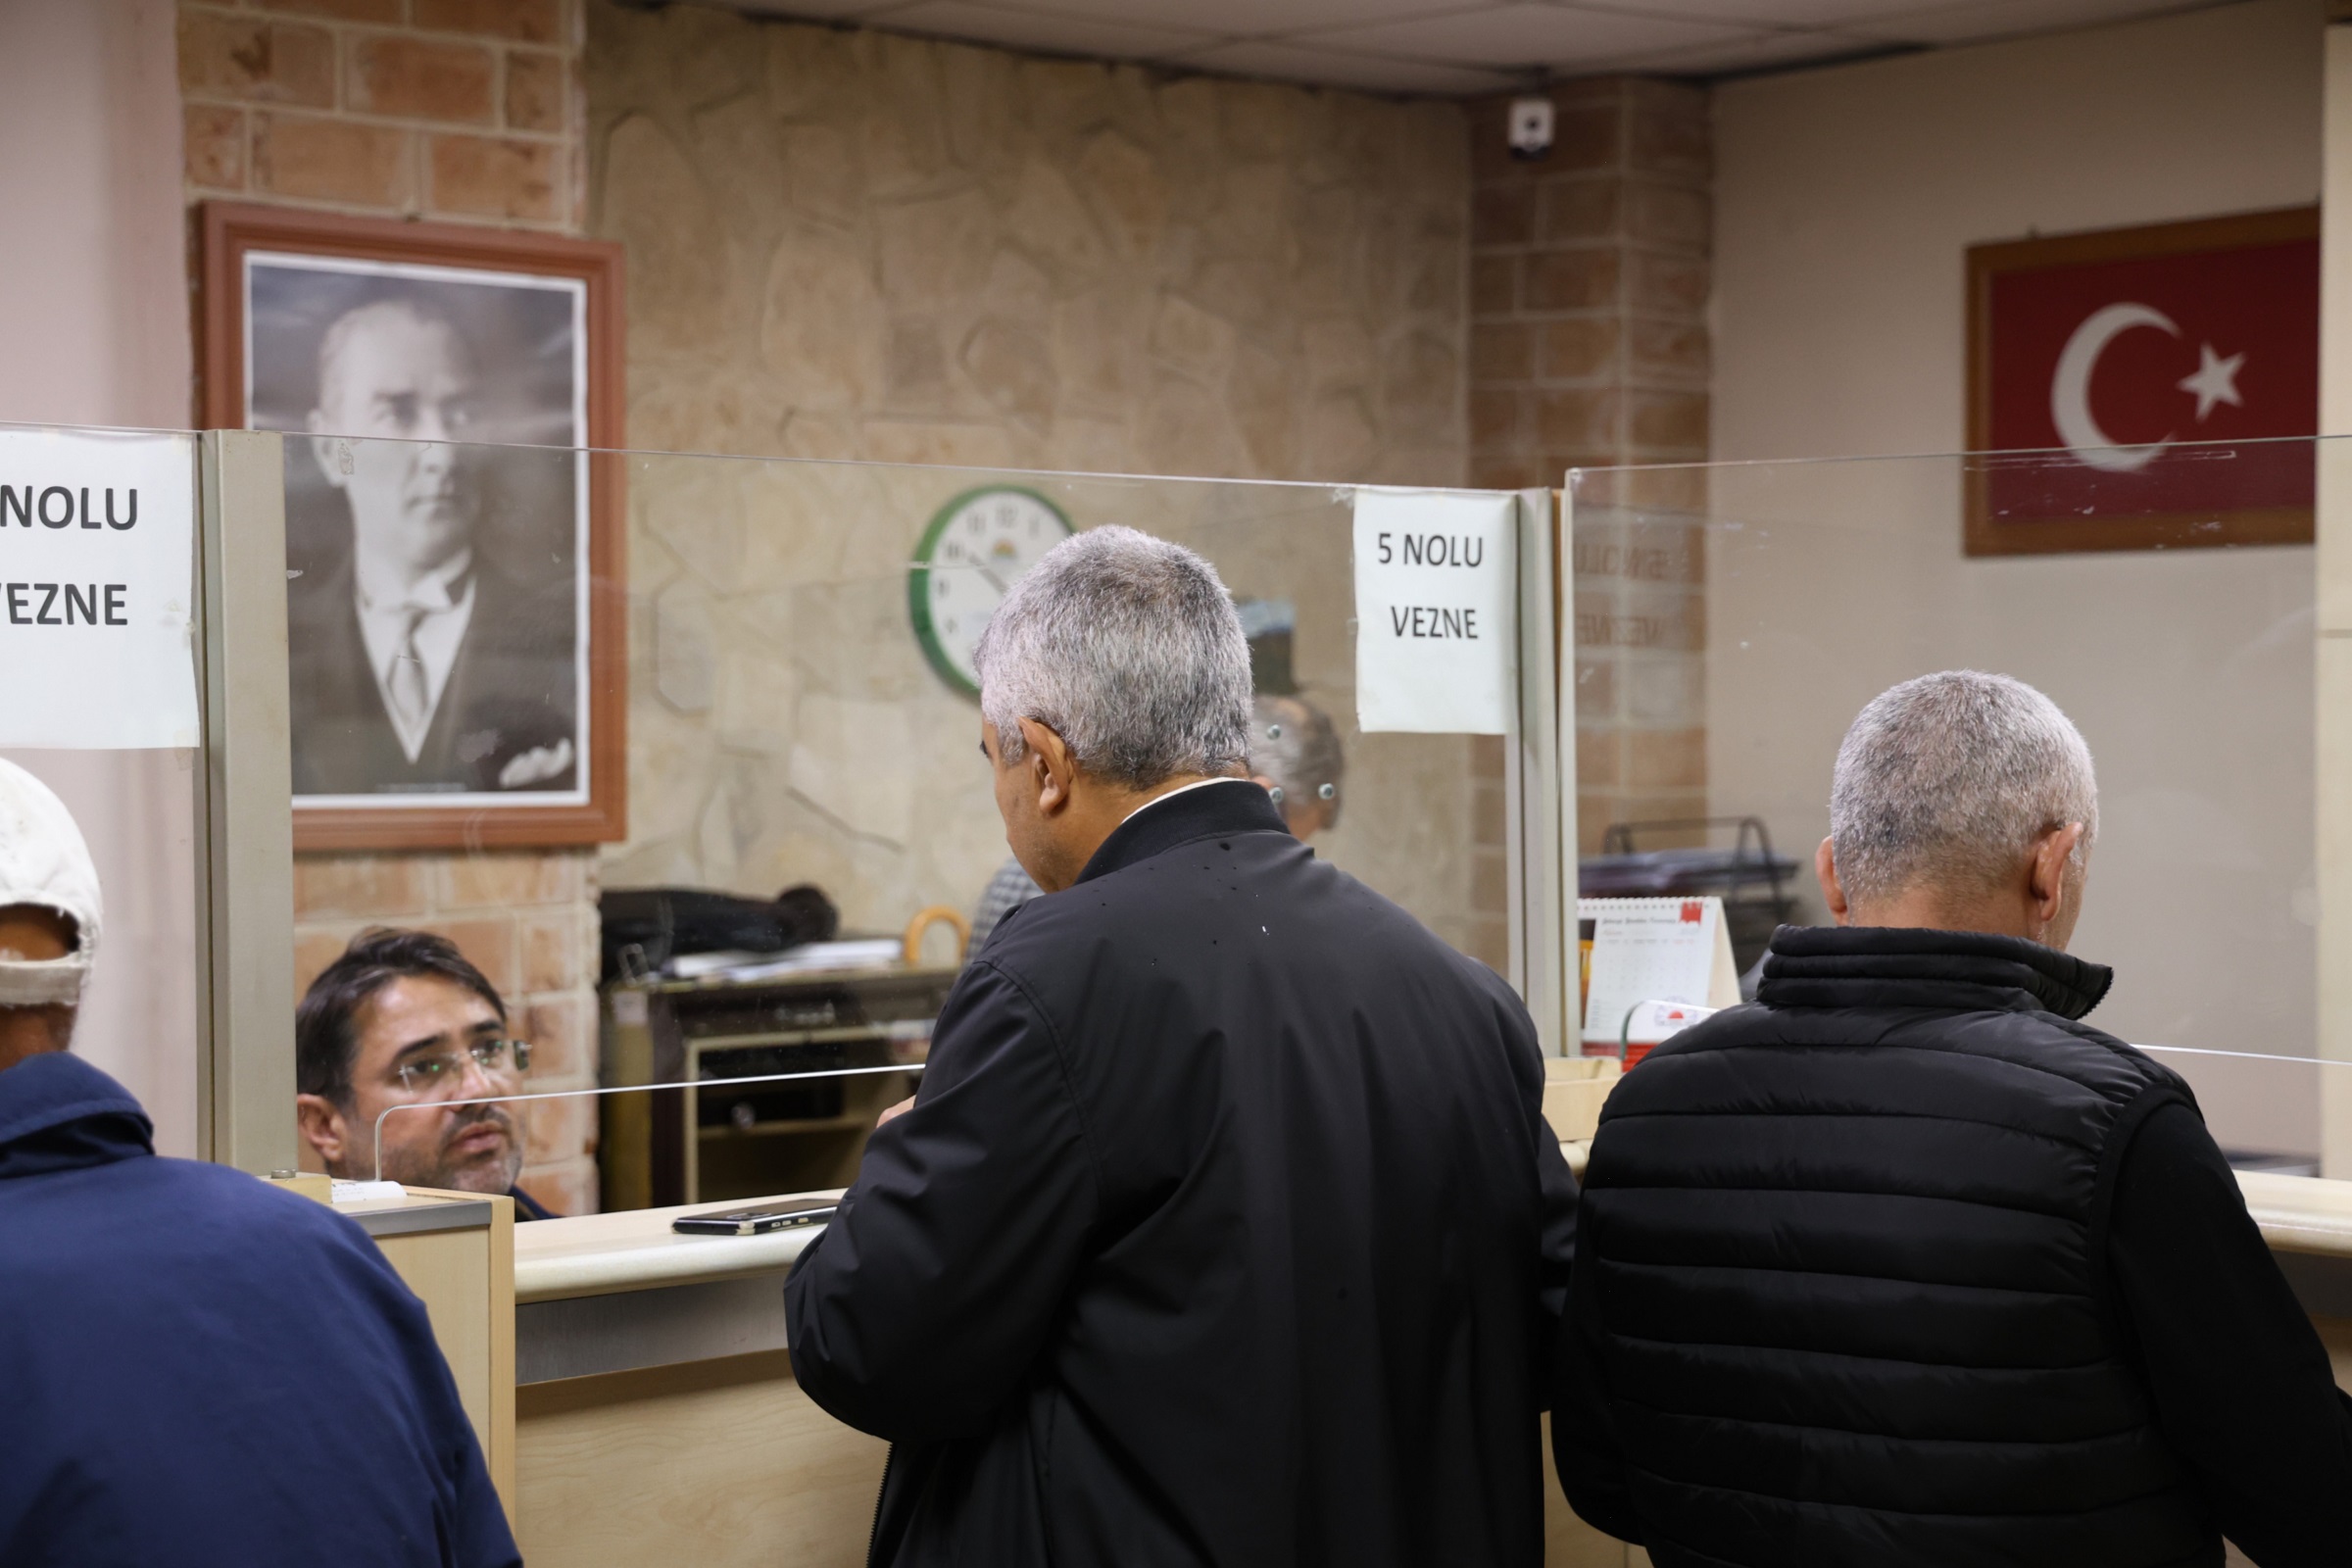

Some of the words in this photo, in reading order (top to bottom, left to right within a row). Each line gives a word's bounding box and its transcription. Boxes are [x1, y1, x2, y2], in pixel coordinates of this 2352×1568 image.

[0, 484, 137, 531] NOLU
[1378, 532, 1393, 564] 5
[1403, 534, 1483, 567] NOLU
[0, 582, 127, 625] EZNE
[1391, 606, 1478, 639] VEZNE
